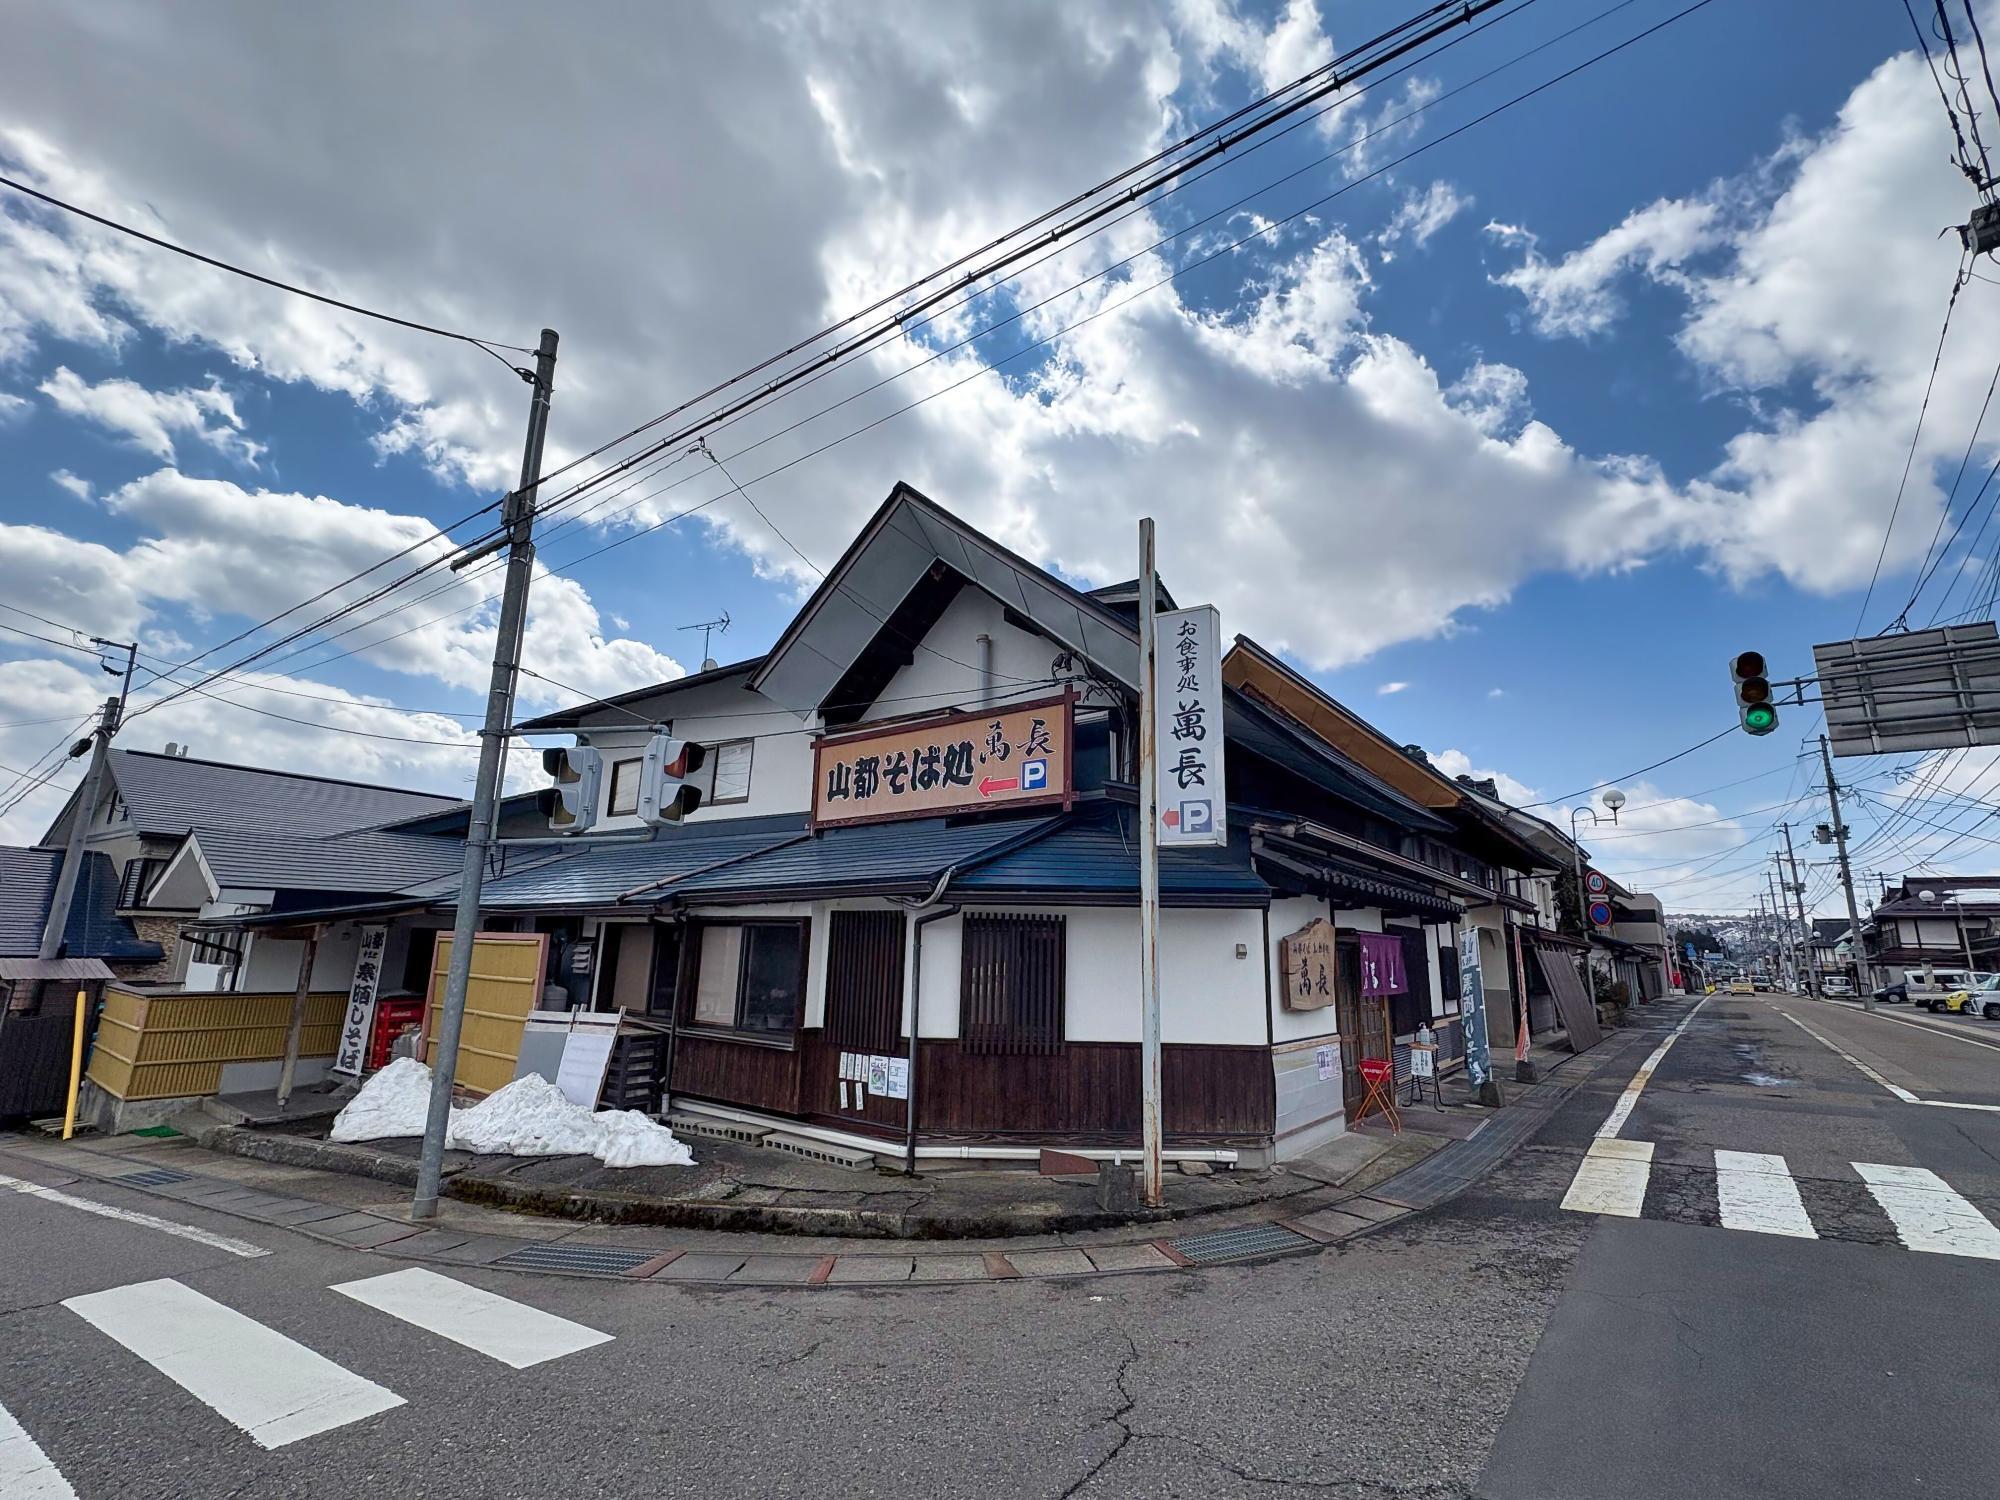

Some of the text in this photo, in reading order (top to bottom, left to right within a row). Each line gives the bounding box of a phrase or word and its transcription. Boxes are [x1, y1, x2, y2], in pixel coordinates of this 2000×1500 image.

[1176, 620, 1199, 693] お食事処
[827, 718, 1056, 803] 山都そば処 萬長
[1168, 700, 1207, 789] 萬長
[1025, 762, 1045, 788] P
[1184, 803, 1210, 832] P
[1591, 877, 1602, 888] 40
